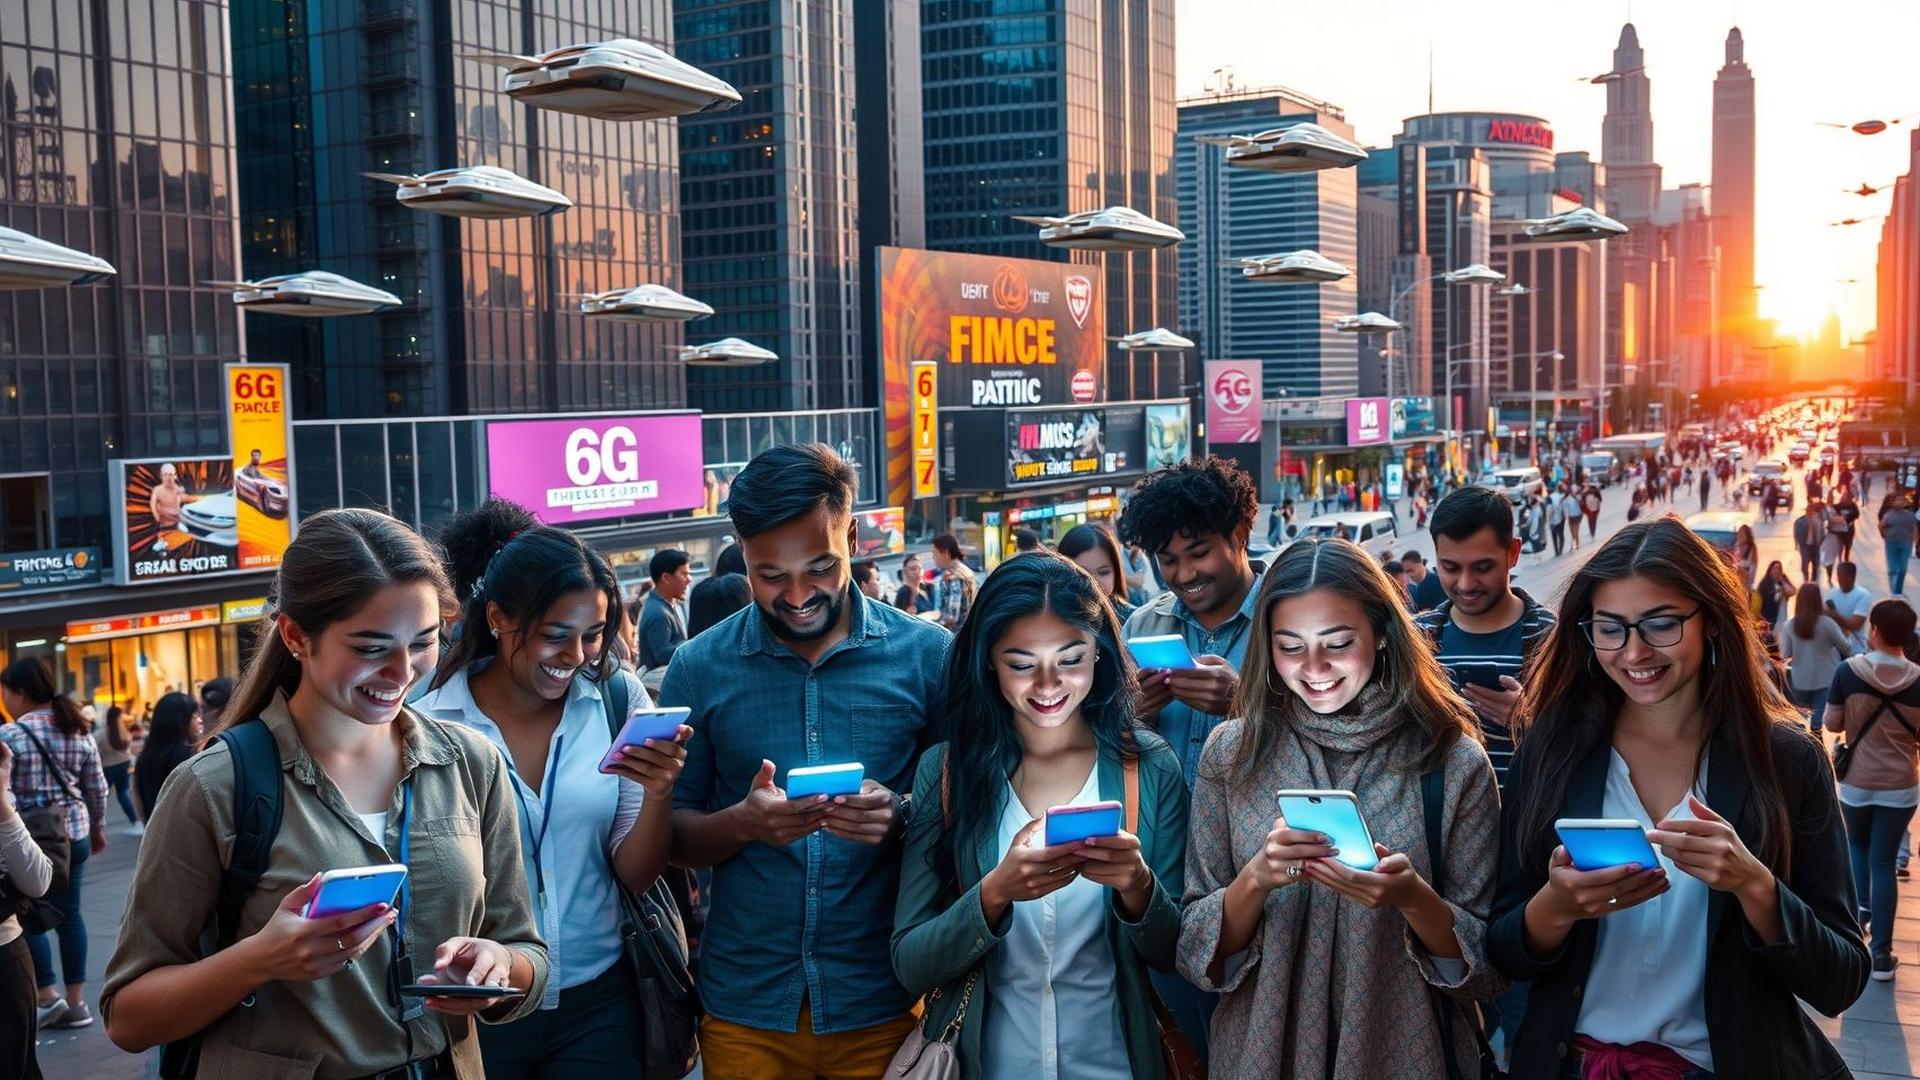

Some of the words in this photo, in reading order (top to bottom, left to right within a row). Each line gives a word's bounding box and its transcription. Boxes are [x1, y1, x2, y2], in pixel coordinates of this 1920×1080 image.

[949, 315, 1057, 364] FIMCE
[235, 373, 276, 399] 6G
[919, 370, 932, 397] 6
[565, 426, 638, 487] 6G
